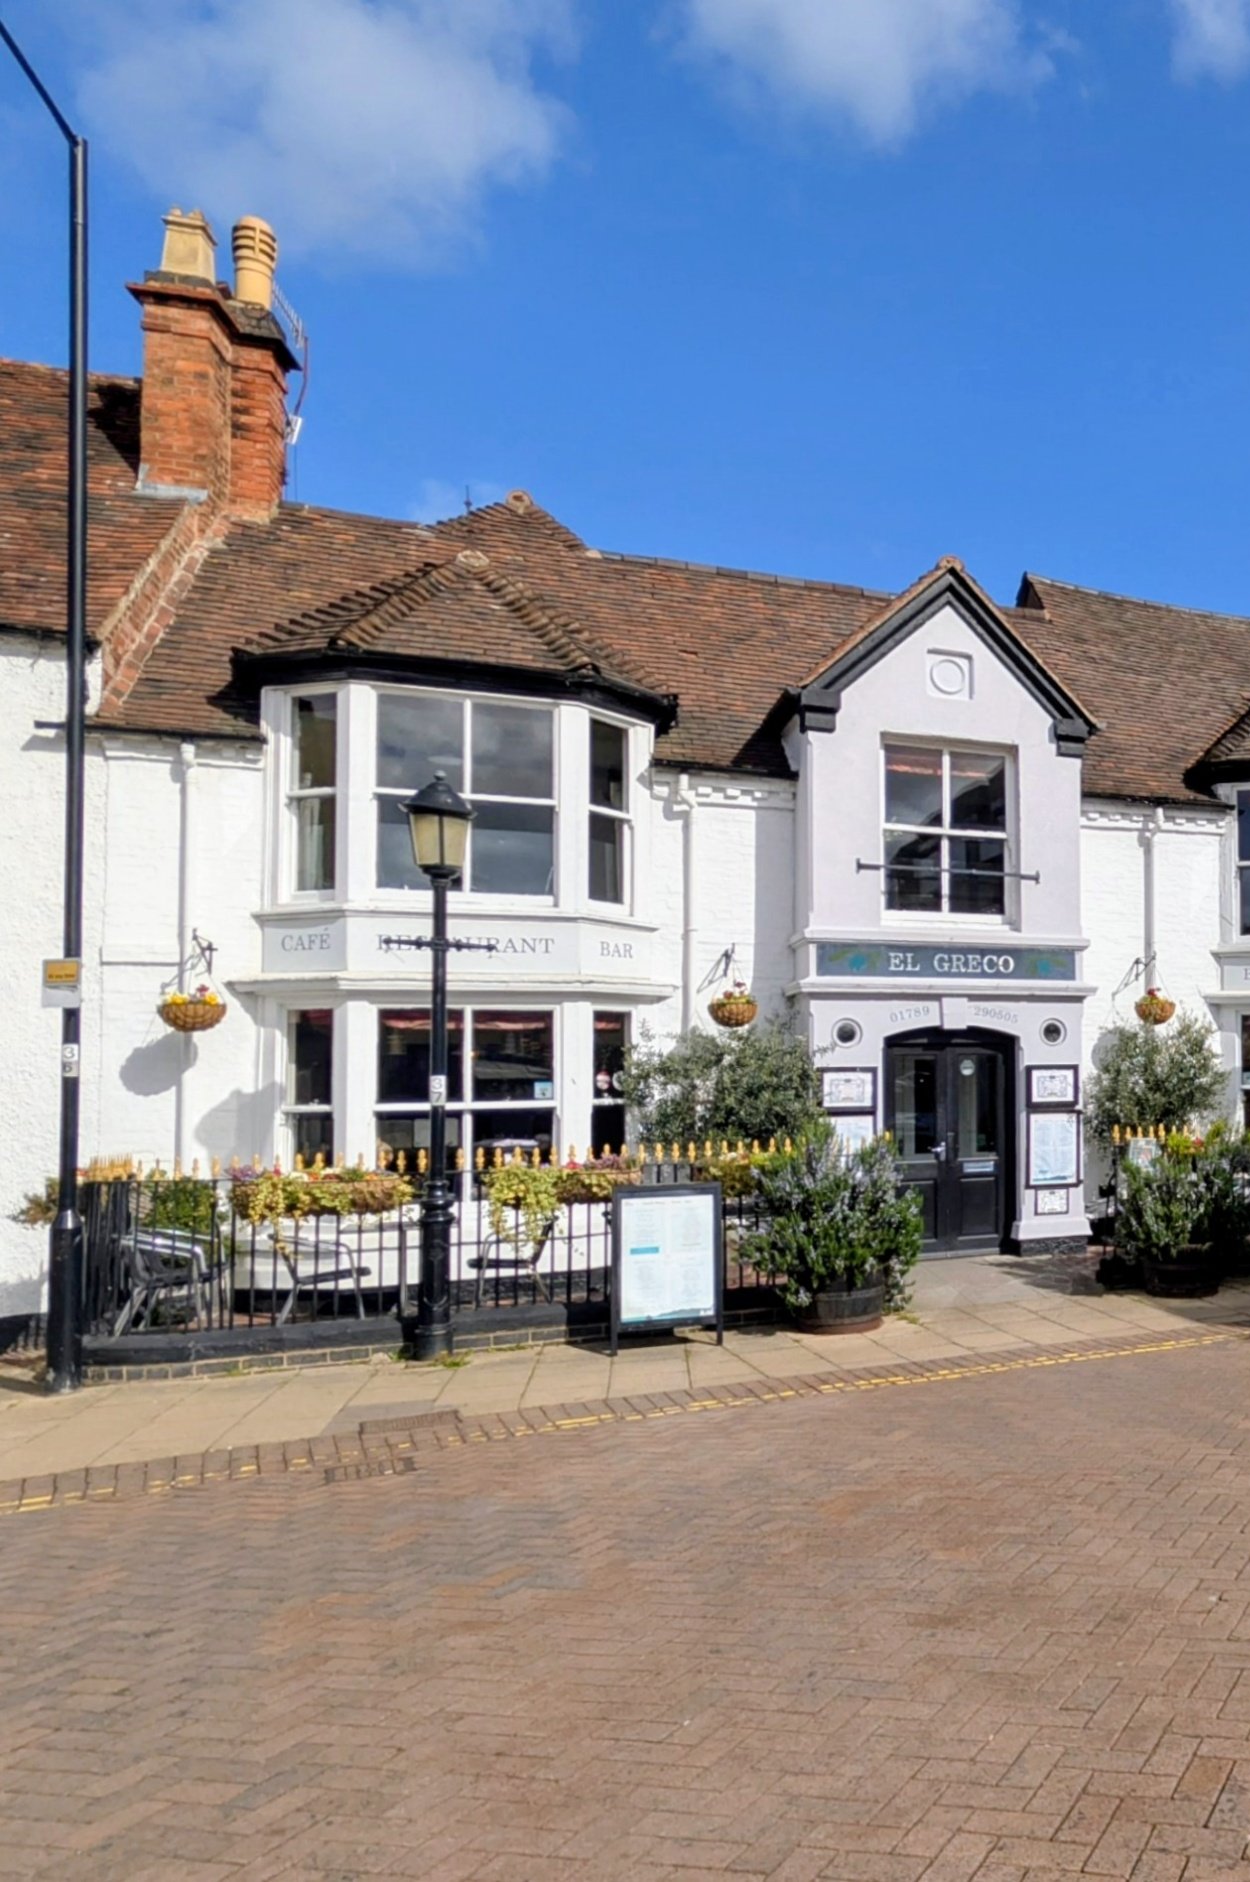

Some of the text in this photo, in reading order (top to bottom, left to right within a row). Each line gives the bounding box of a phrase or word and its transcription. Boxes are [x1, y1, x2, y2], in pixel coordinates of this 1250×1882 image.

[281, 928, 331, 952] CAFÉ
[599, 940, 633, 959] BAR
[888, 953, 1015, 973] EL GRECO
[889, 1006, 930, 1022] 01789
